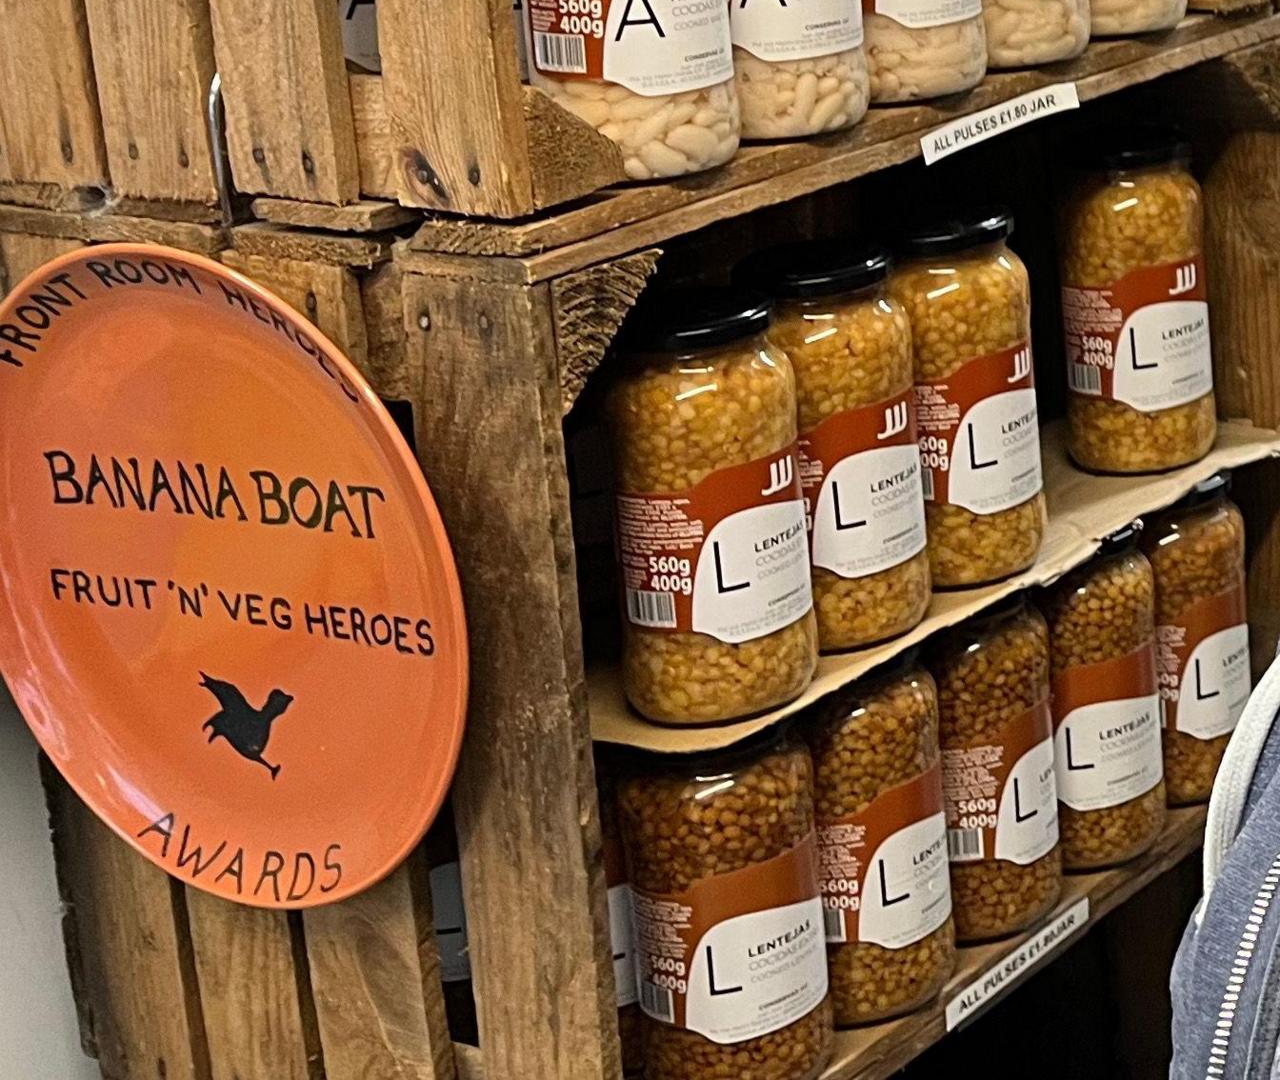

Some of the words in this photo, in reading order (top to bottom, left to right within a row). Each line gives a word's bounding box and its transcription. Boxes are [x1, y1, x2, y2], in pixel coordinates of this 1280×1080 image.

[560, 16, 605, 38] 400g
[933, 134, 953, 154] ALL
[954, 115, 998, 145] PULSES
[1030, 94, 1057, 113] JAR
[0, 271, 86, 368] FRONT
[94, 260, 203, 296] ROOM
[1082, 336, 1112, 353] 560g
[1083, 350, 1114, 369] 400g
[1129, 326, 1158, 370] L
[967, 422, 998, 470] L
[42, 449, 248, 523] BANANA
[249, 468, 386, 540] BOAT
[832, 480, 867, 531] L
[649, 555, 691, 576] 560g
[651, 574, 693, 596] 400g
[713, 540, 751, 594] L
[50, 568, 159, 612] FRUIT
[219, 589, 292, 630] VEG
[304, 604, 437, 657] HEROES
[1195, 657, 1220, 700] L
[1065, 726, 1095, 771] L
[958, 798, 997, 814] 560g
[959, 813, 997, 830] 400g
[1014, 777, 1038, 823] L
[136, 810, 345, 904] AWARDS
[879, 858, 911, 907] L
[748, 919, 812, 959] LENTEJAS
[651, 954, 686, 976] 560g
[652, 972, 687, 994] 400g
[706, 944, 743, 997] L
[959, 989, 982, 1013] ALL
[983, 952, 1027, 995] PULSES
